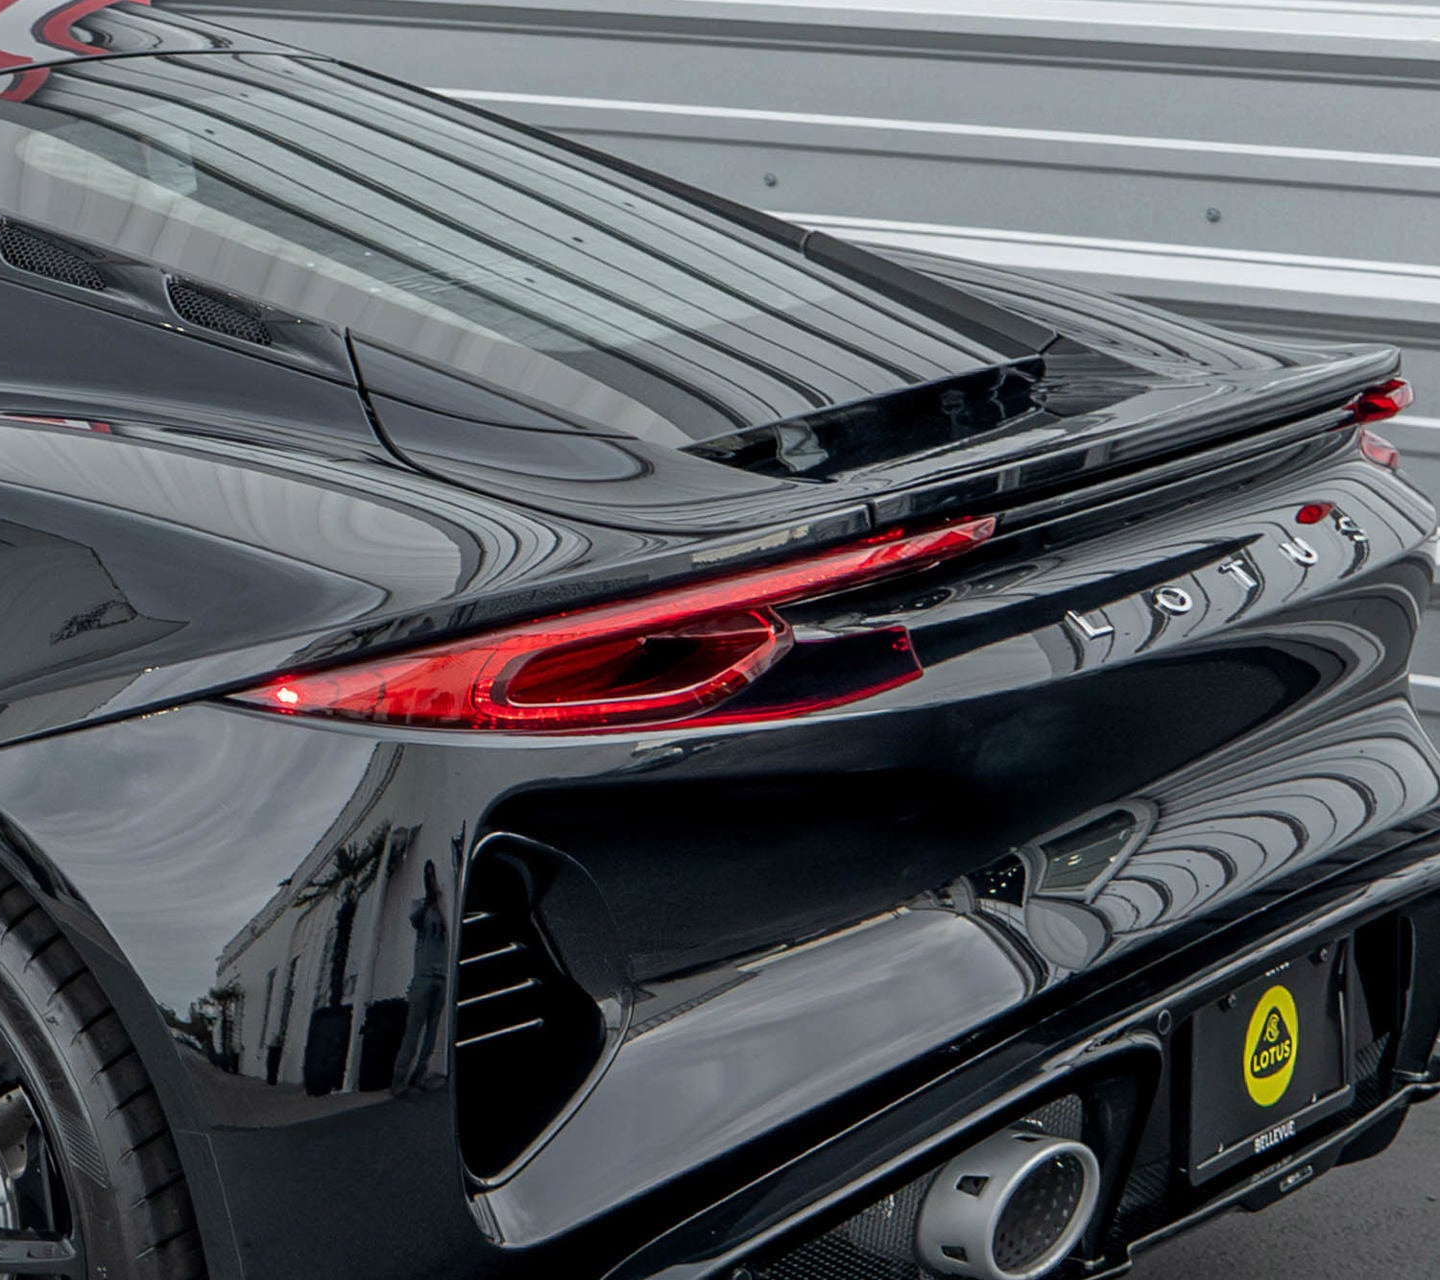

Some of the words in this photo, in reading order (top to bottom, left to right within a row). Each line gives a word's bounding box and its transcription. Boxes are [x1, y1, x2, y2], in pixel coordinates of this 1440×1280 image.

[1065, 514, 1369, 639] LOTUS
[1253, 1039, 1291, 1072] LOTUS
[1254, 1119, 1296, 1154] BELLEVUE
